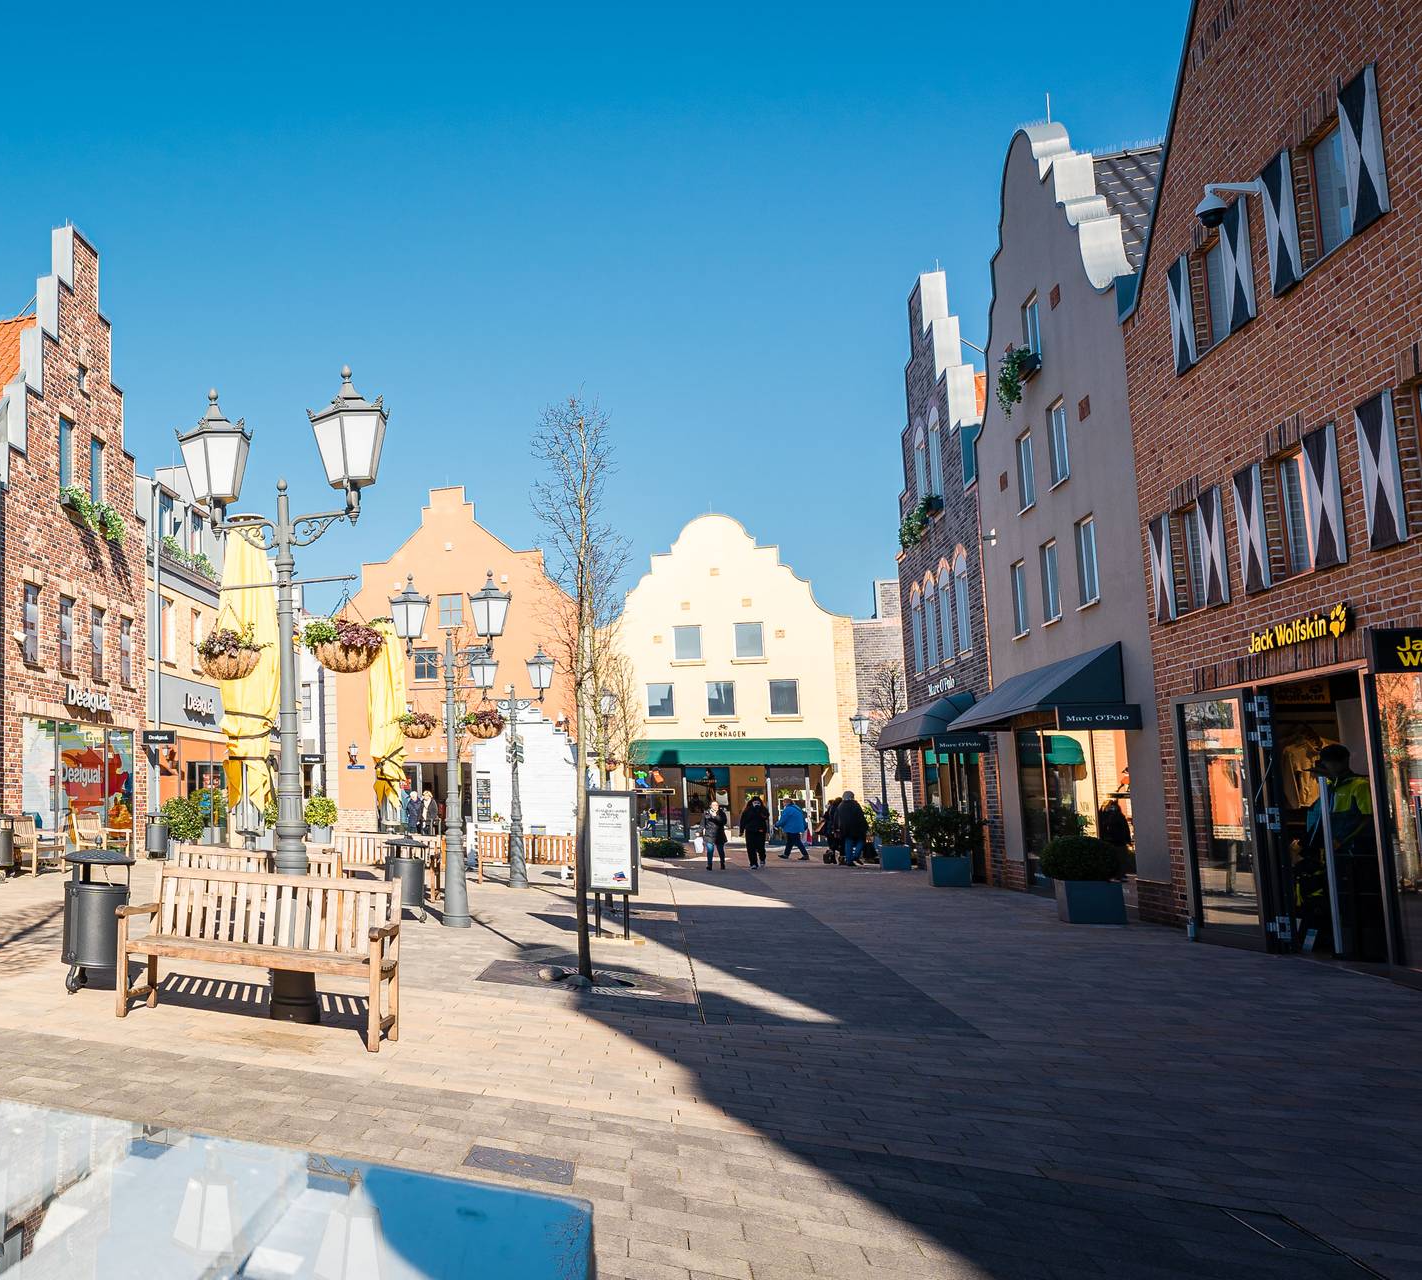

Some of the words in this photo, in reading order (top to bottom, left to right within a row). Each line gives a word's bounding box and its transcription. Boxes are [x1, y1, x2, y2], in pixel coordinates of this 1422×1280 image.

[1248, 628, 1274, 653] Jack
[1274, 614, 1327, 647] Wolfskin
[1397, 651, 1422, 667] W
[700, 730, 746, 738] COPENHAGEN
